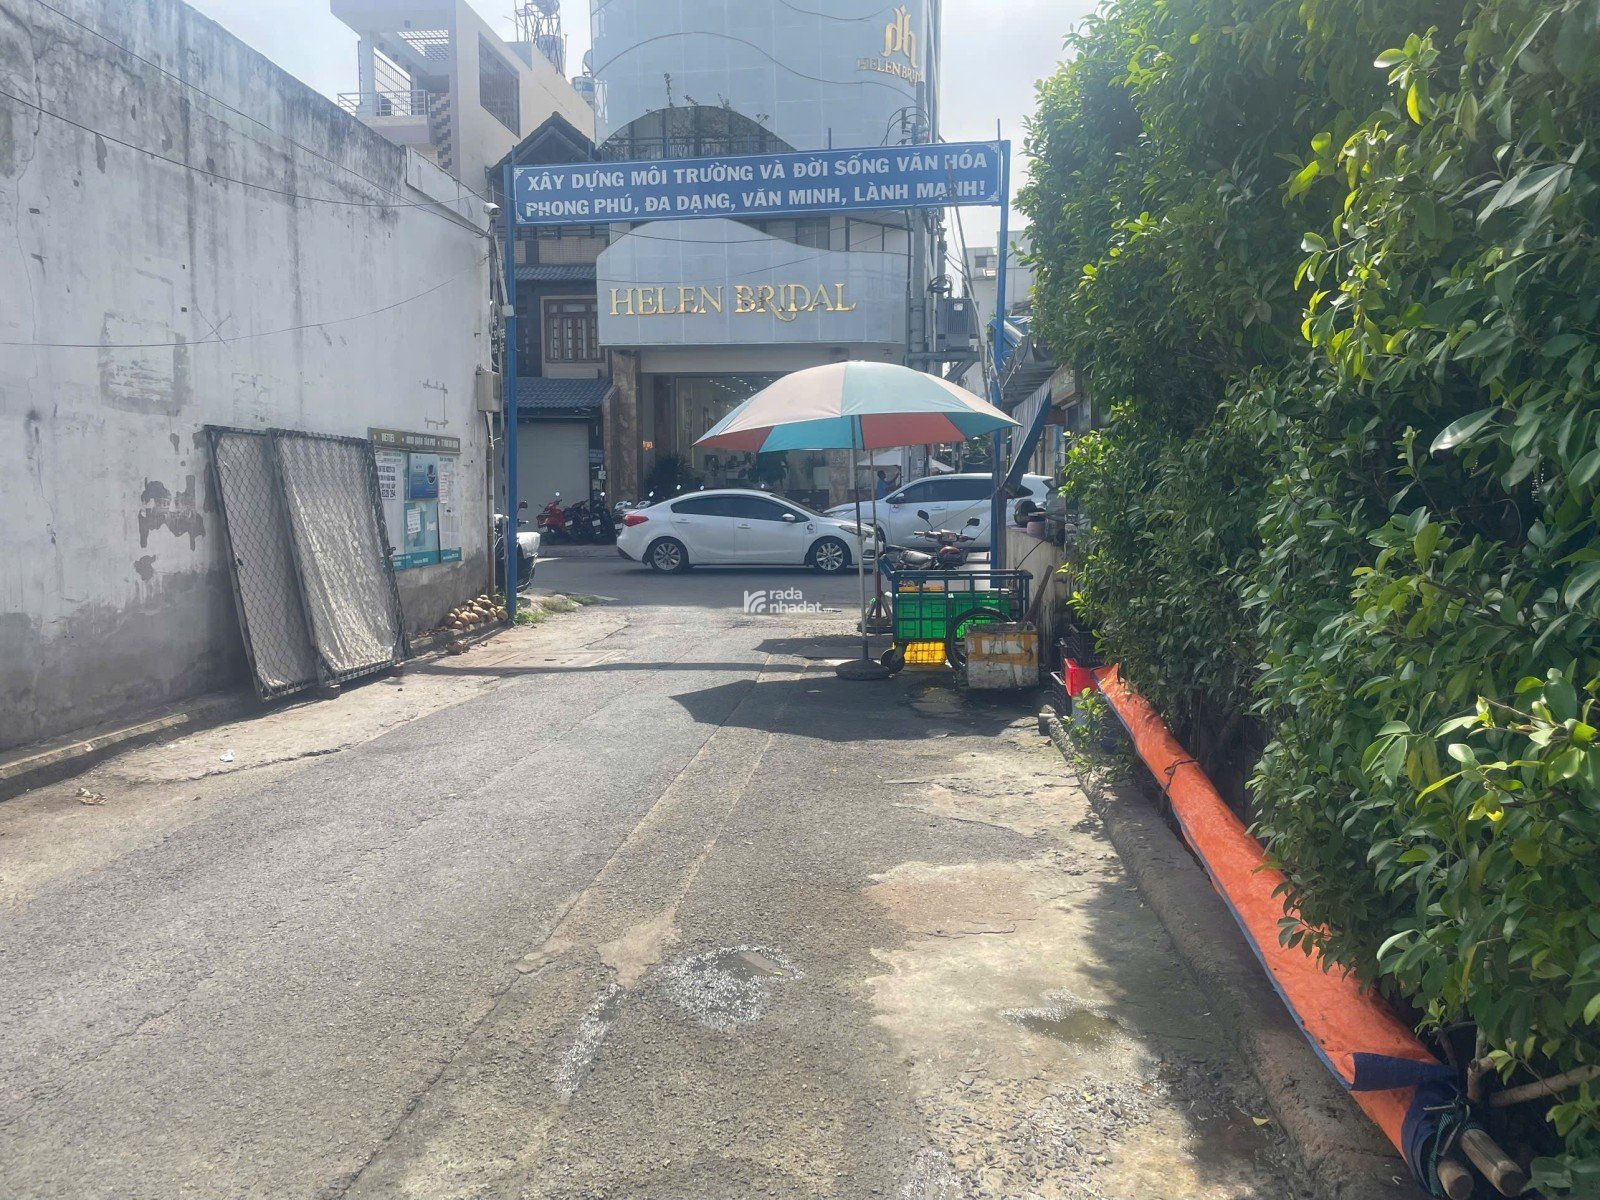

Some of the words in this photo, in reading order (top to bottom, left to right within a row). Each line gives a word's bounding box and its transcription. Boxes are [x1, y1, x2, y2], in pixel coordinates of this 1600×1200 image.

[528, 172, 565, 191] XÂY
[572, 169, 625, 192] DỰNG
[631, 165, 668, 186] MÔI
[674, 162, 753, 184] TRƯỜNG
[760, 159, 786, 180] VÀ
[793, 156, 829, 178] ĐỜI
[834, 152, 890, 176] SỐNG
[897, 152, 939, 172] VĂN
[944, 148, 988, 170] HÓA
[526, 200, 590, 217] PHONG
[594, 193, 640, 215] PHÚ,
[645, 195, 670, 212] ĐA
[677, 192, 736, 214] DẠNG,
[742, 188, 782, 207] VĂN
[789, 187, 848, 206] MINH,
[854, 181, 909, 202] LÀNH
[609, 286, 724, 315] HELEN
[734, 283, 857, 322] BRIDAL
